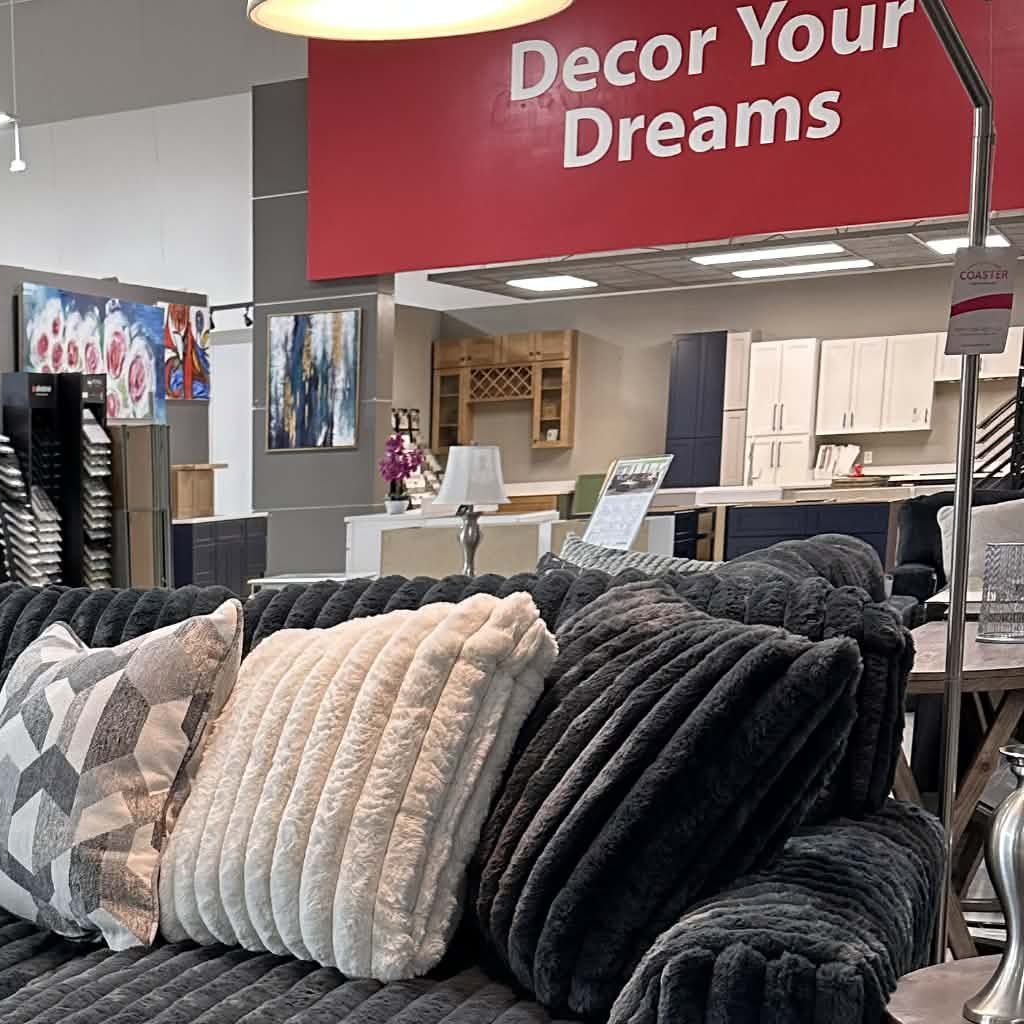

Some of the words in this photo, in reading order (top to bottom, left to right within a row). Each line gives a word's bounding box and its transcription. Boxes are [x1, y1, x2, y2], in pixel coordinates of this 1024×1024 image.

[511, 26, 717, 101] Decor
[736, 0, 915, 67] Your
[563, 90, 841, 168] Dreams
[959, 270, 1009, 281] COASTER
